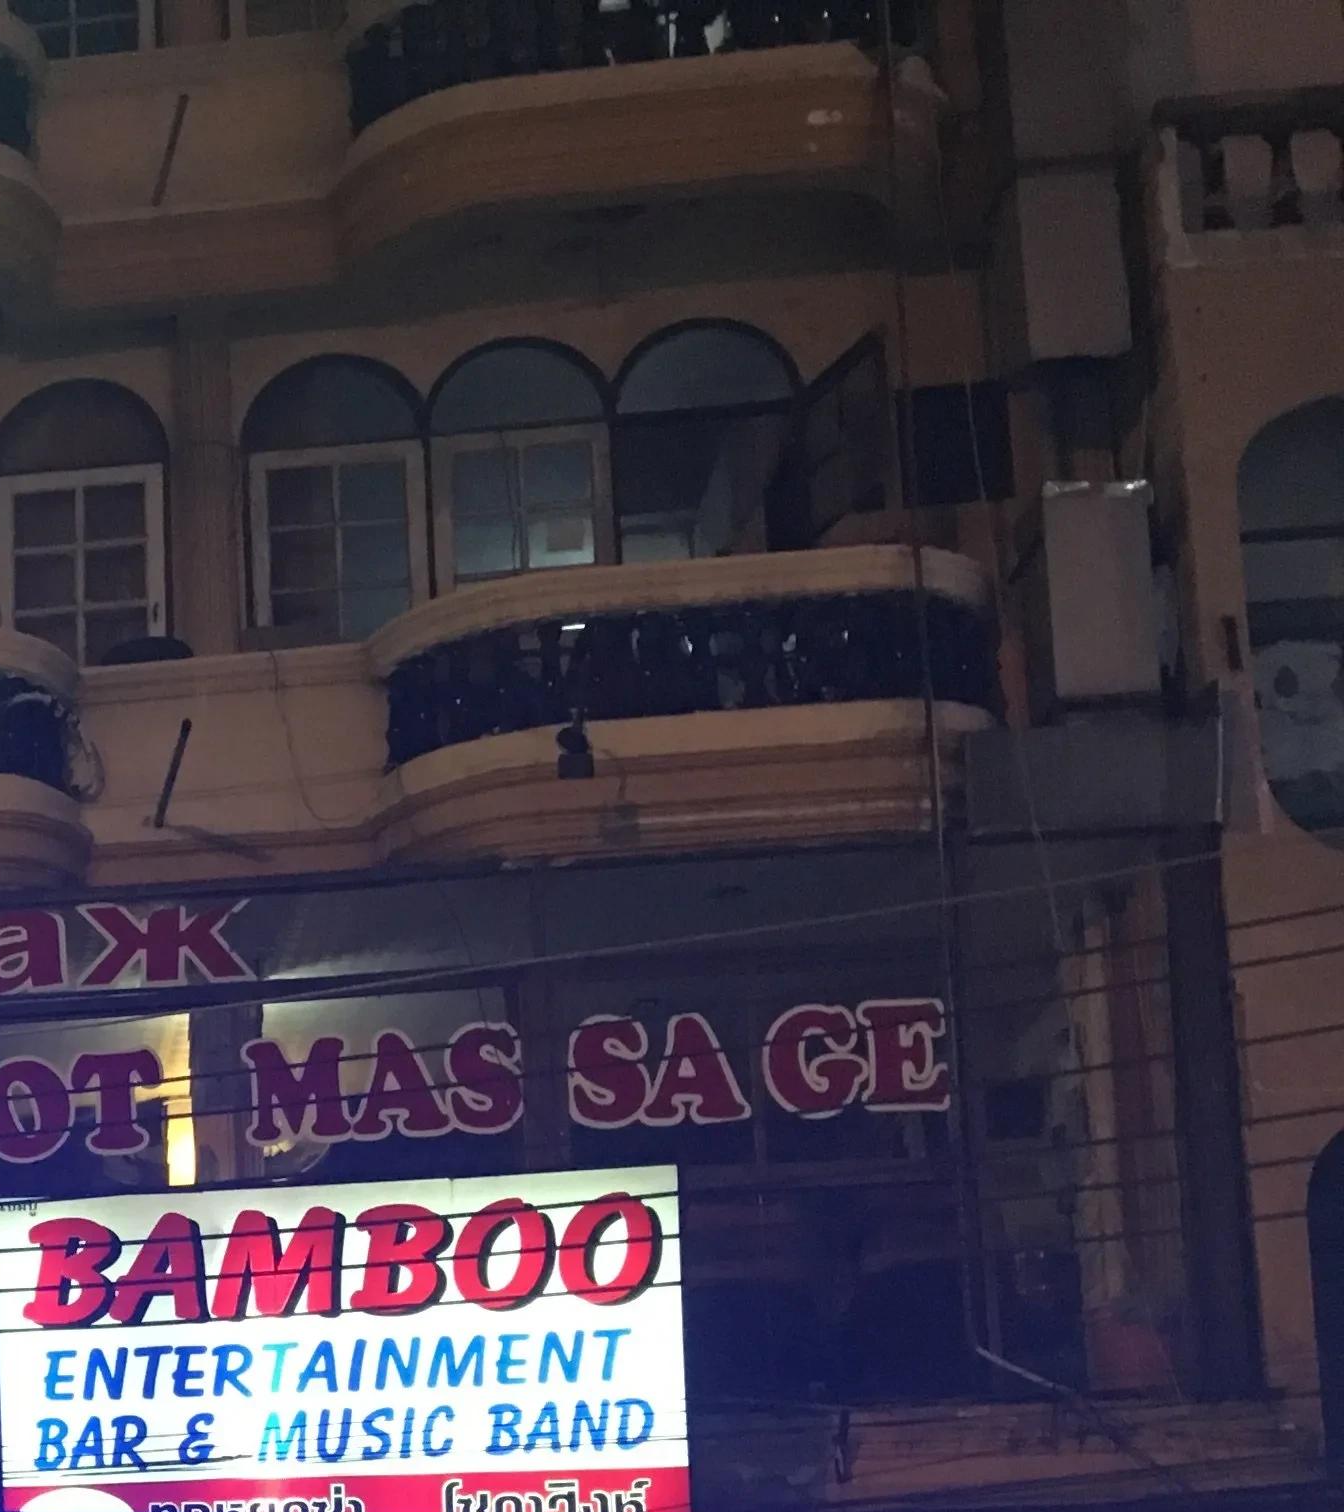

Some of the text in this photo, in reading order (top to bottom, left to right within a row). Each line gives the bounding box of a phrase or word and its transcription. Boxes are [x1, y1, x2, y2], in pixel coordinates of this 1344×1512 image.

[21, 1192, 663, 1328] BAMBOO
[43, 1328, 631, 1401] ENTERTAINMENT
[35, 1398, 656, 1472] BAR & MUSIC BAND
